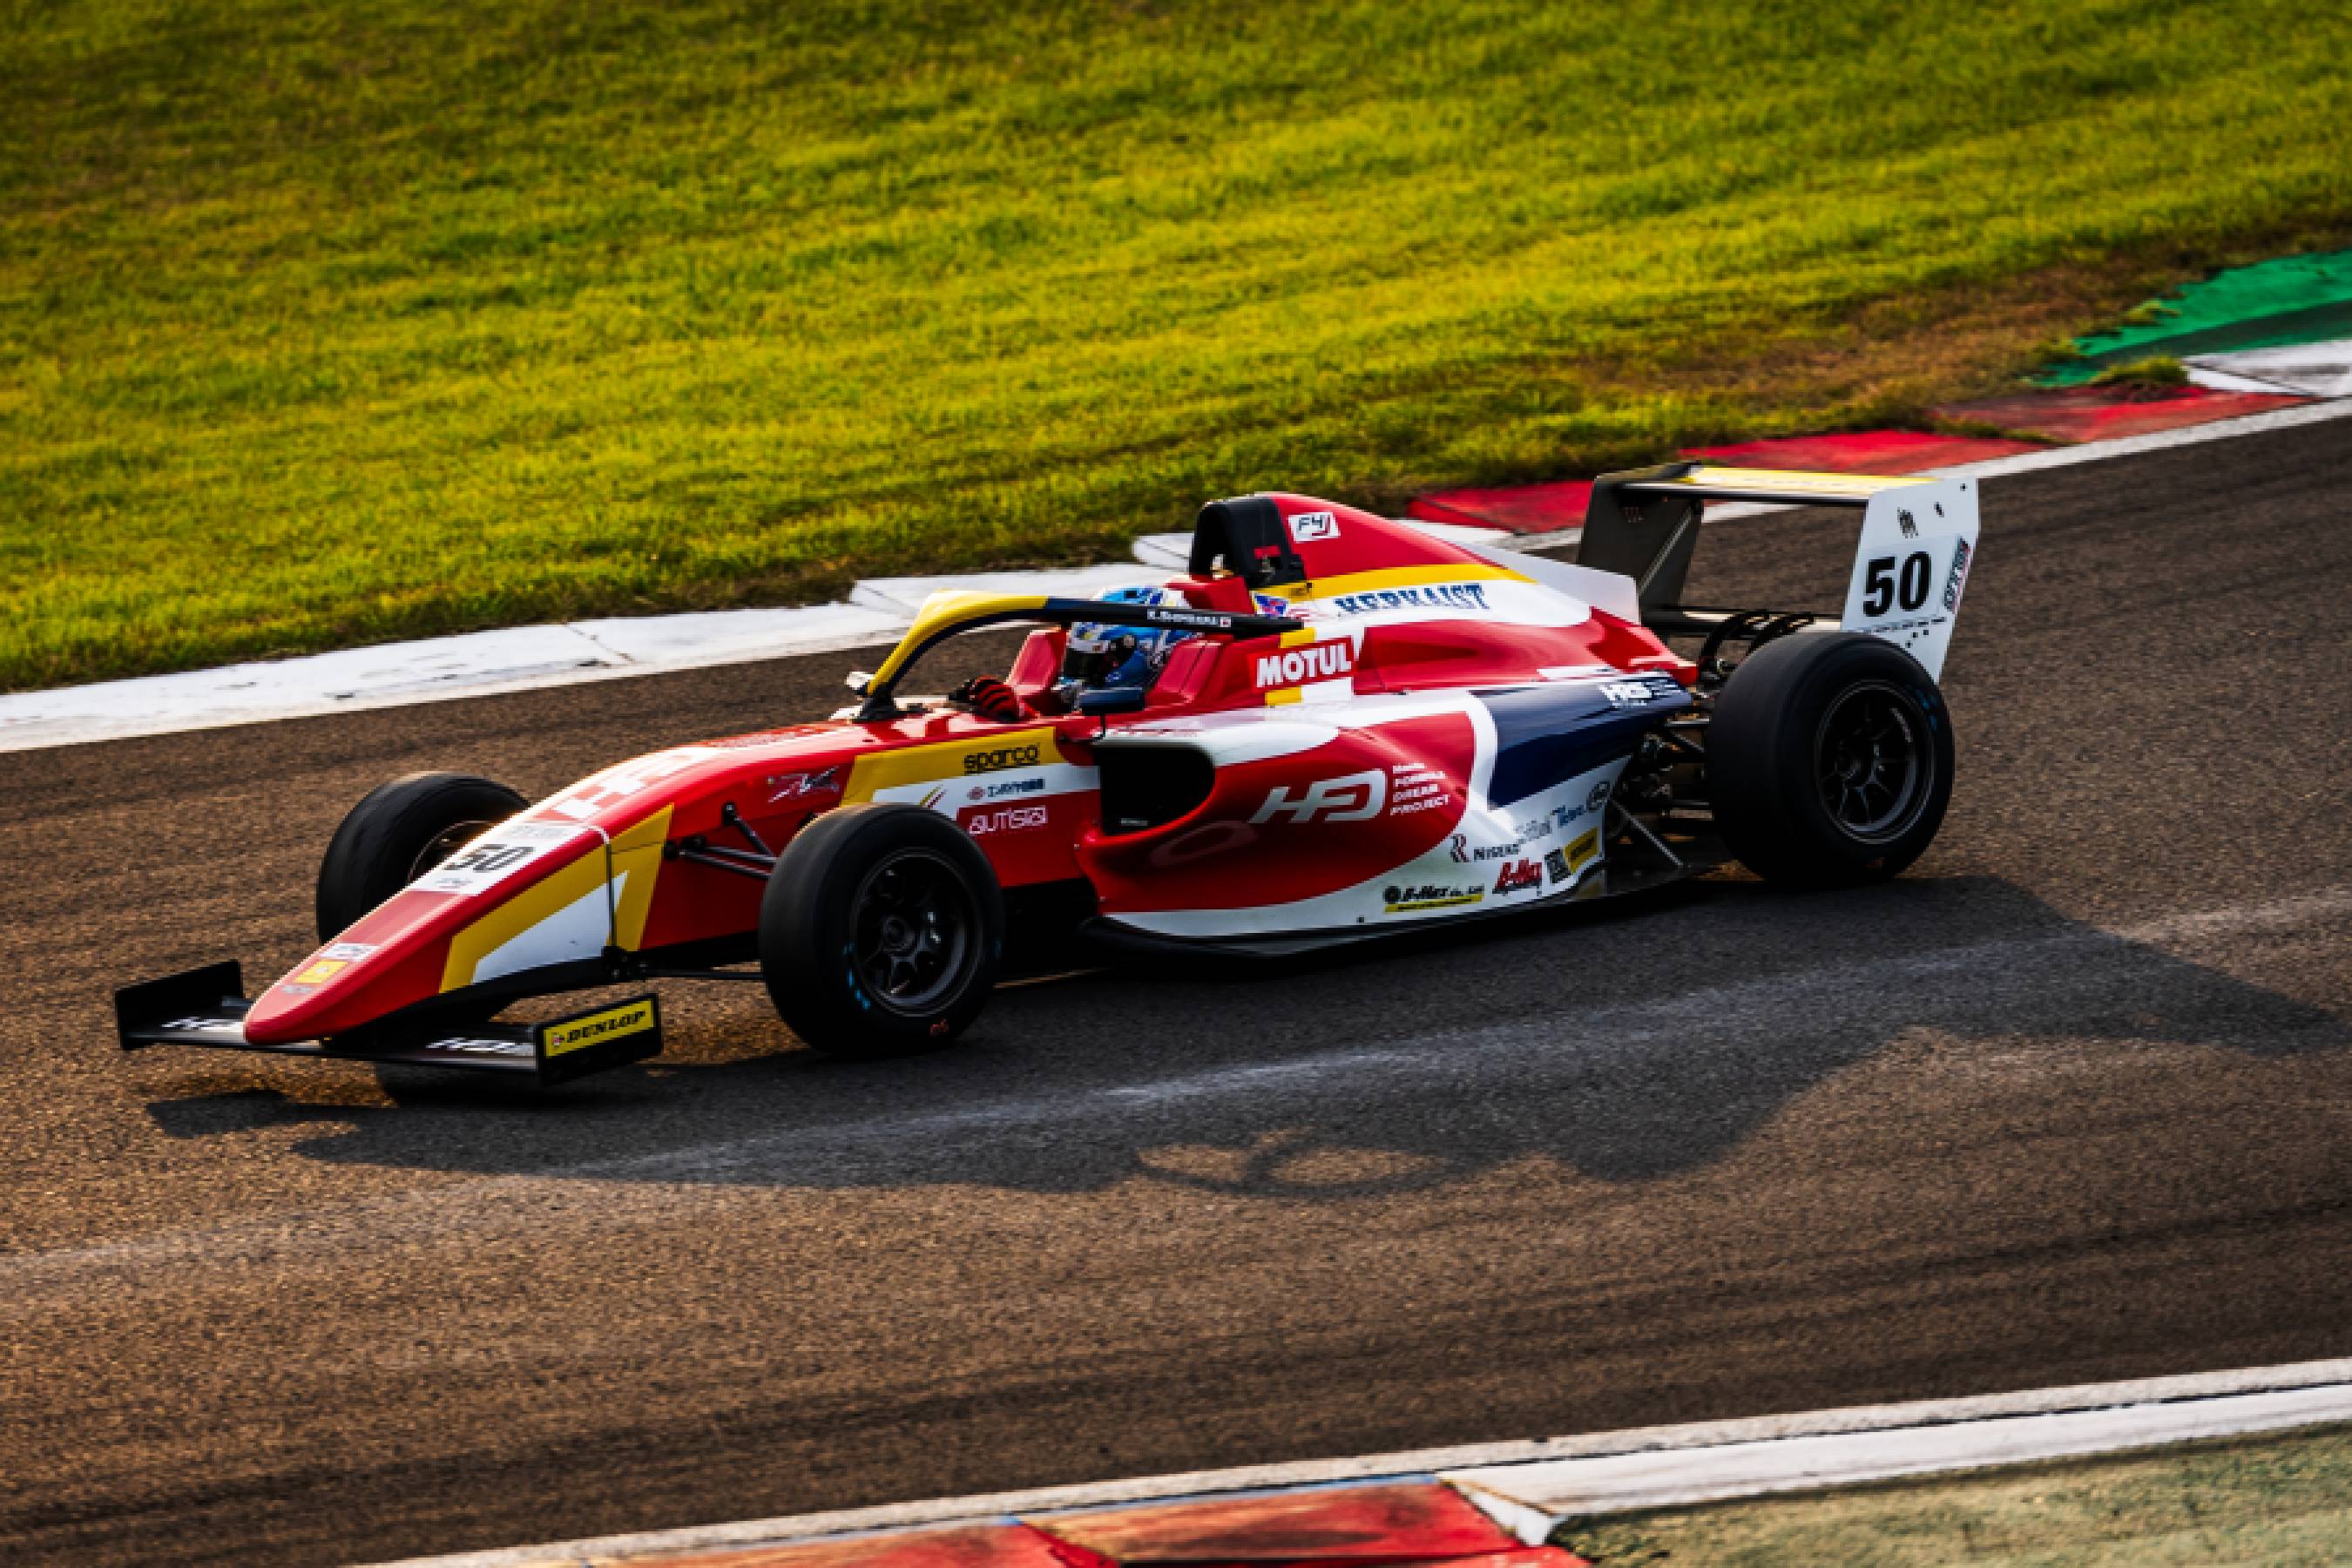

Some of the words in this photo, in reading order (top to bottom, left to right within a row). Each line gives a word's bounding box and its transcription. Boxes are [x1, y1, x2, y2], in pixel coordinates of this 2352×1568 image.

[1862, 551, 1932, 618] 50
[1256, 643, 1352, 688] MOTUL
[963, 745, 1039, 774] sparco
[441, 843, 535, 873] 50
[566, 1009, 646, 1044] DUNLOP
